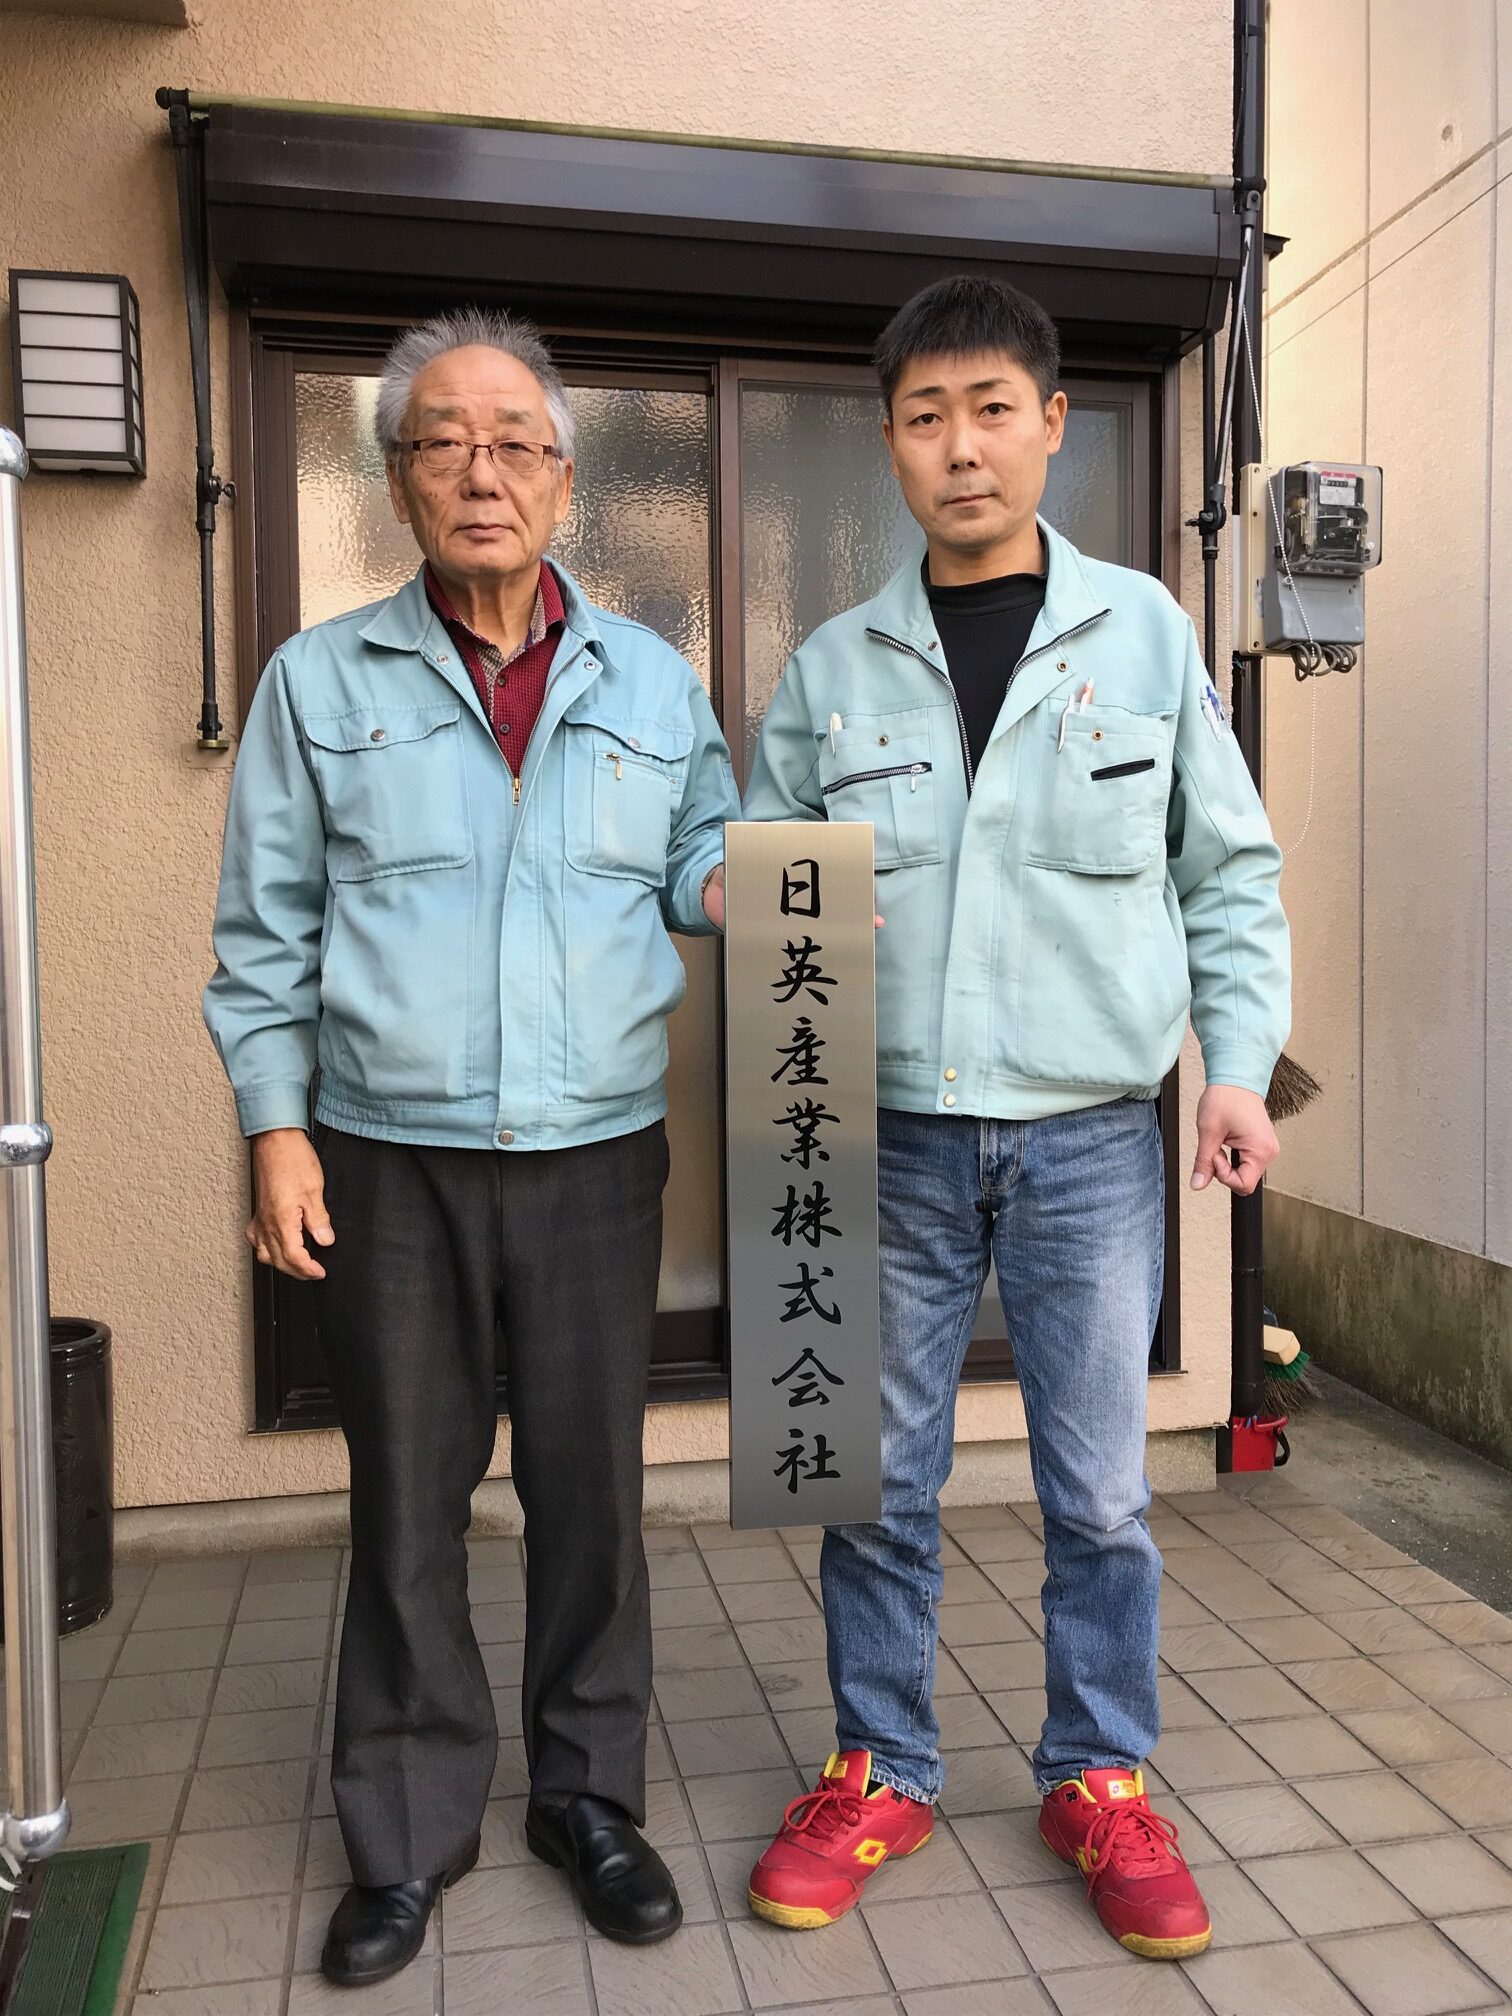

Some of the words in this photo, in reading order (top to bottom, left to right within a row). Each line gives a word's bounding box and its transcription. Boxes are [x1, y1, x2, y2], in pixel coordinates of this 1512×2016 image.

[770, 858, 845, 1494] 日英産業株式会社
